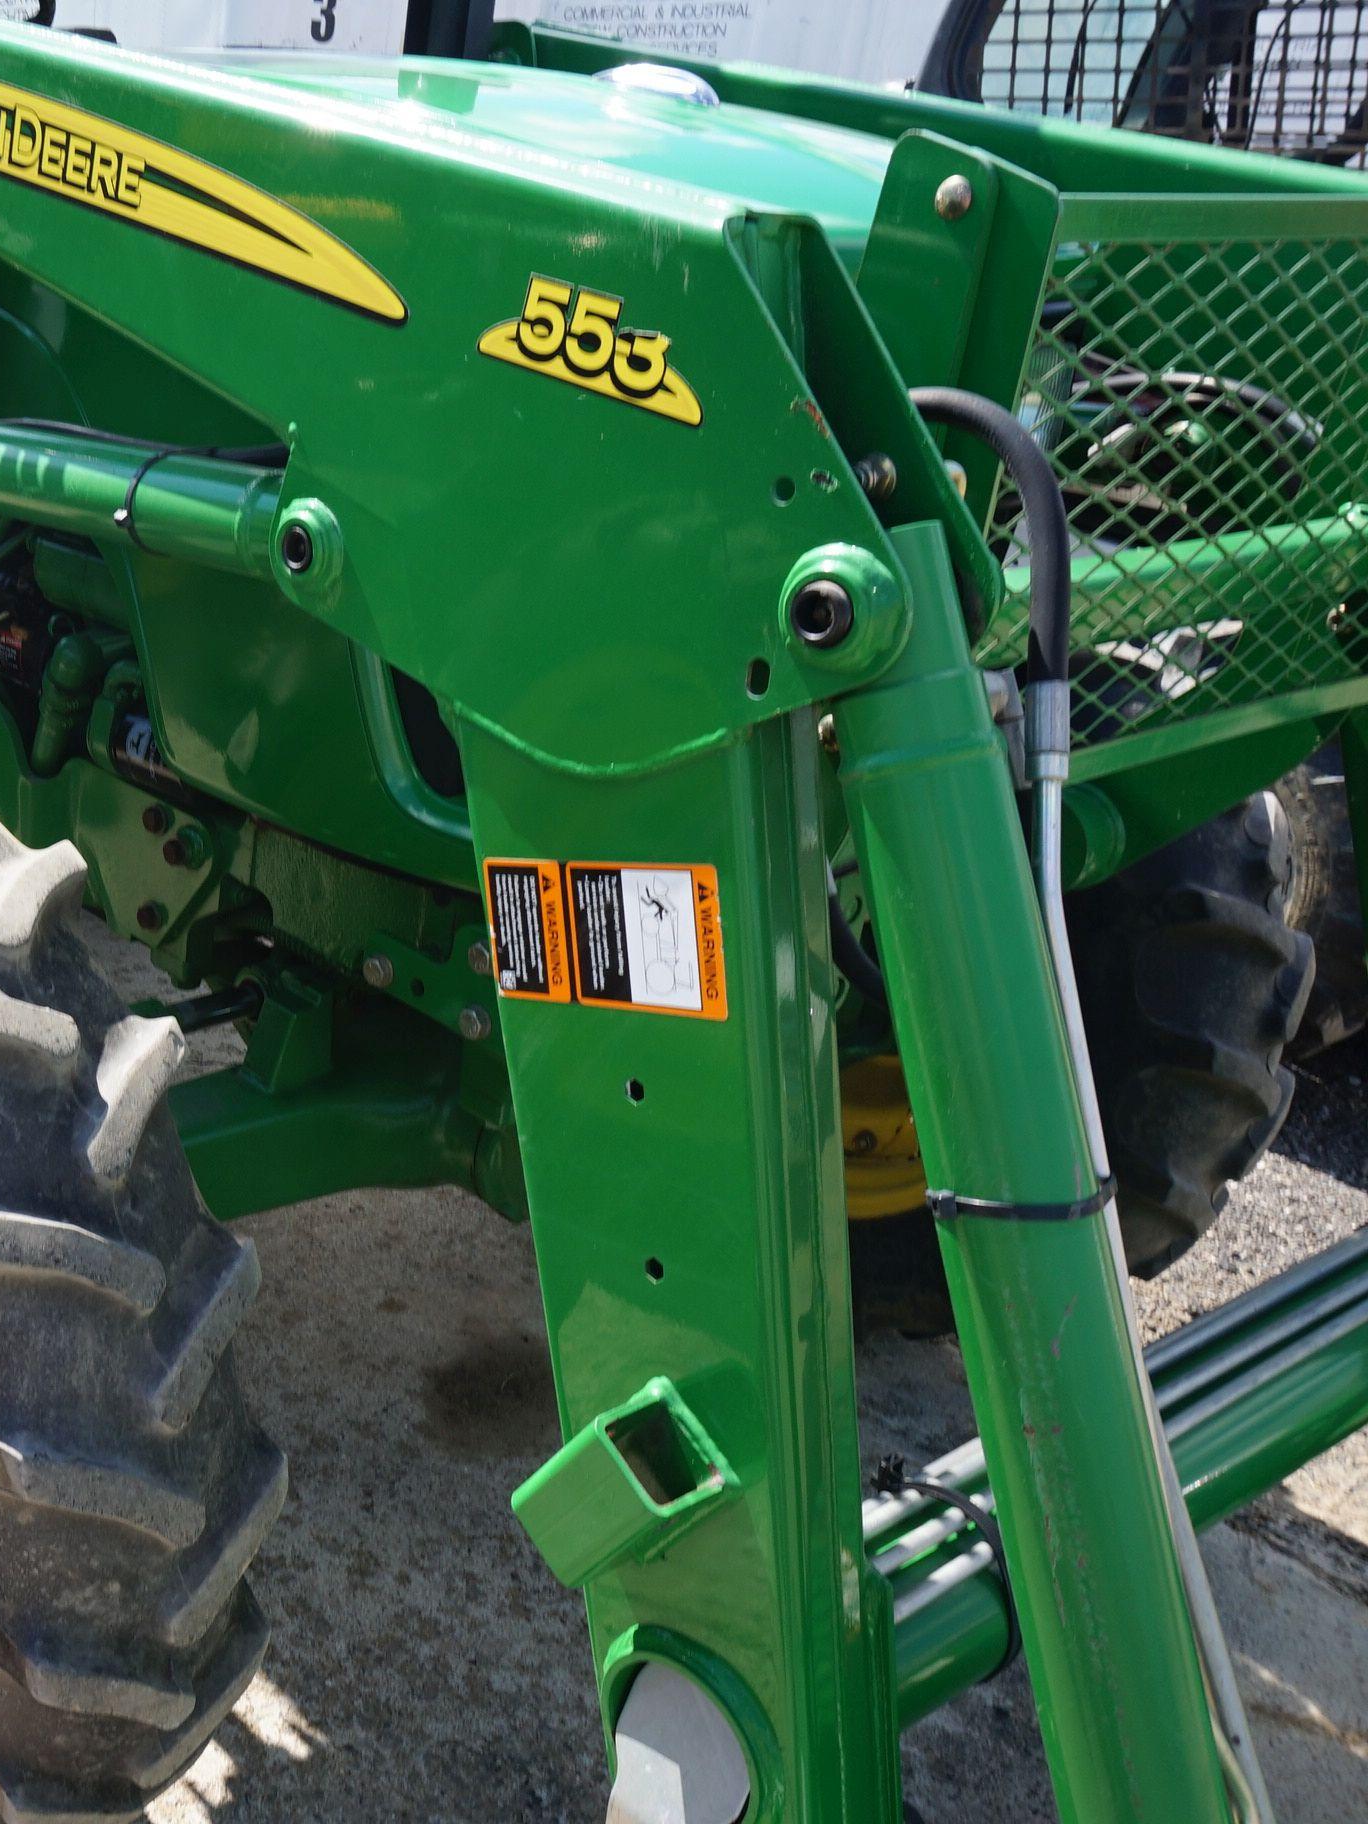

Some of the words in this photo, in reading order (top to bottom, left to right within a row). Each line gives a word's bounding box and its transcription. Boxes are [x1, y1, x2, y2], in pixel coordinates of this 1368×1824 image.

[311, 0, 337, 42] 3
[563, 5, 647, 21] COMMERCIAL
[654, 4, 665, 19] &
[670, 3, 750, 20] INDUSTRIAL
[617, 22, 727, 39] CONSTRUCTION
[8, 103, 146, 210] DEERE
[545, 900, 563, 987] WARNING
[699, 906, 720, 1001] WARNING
